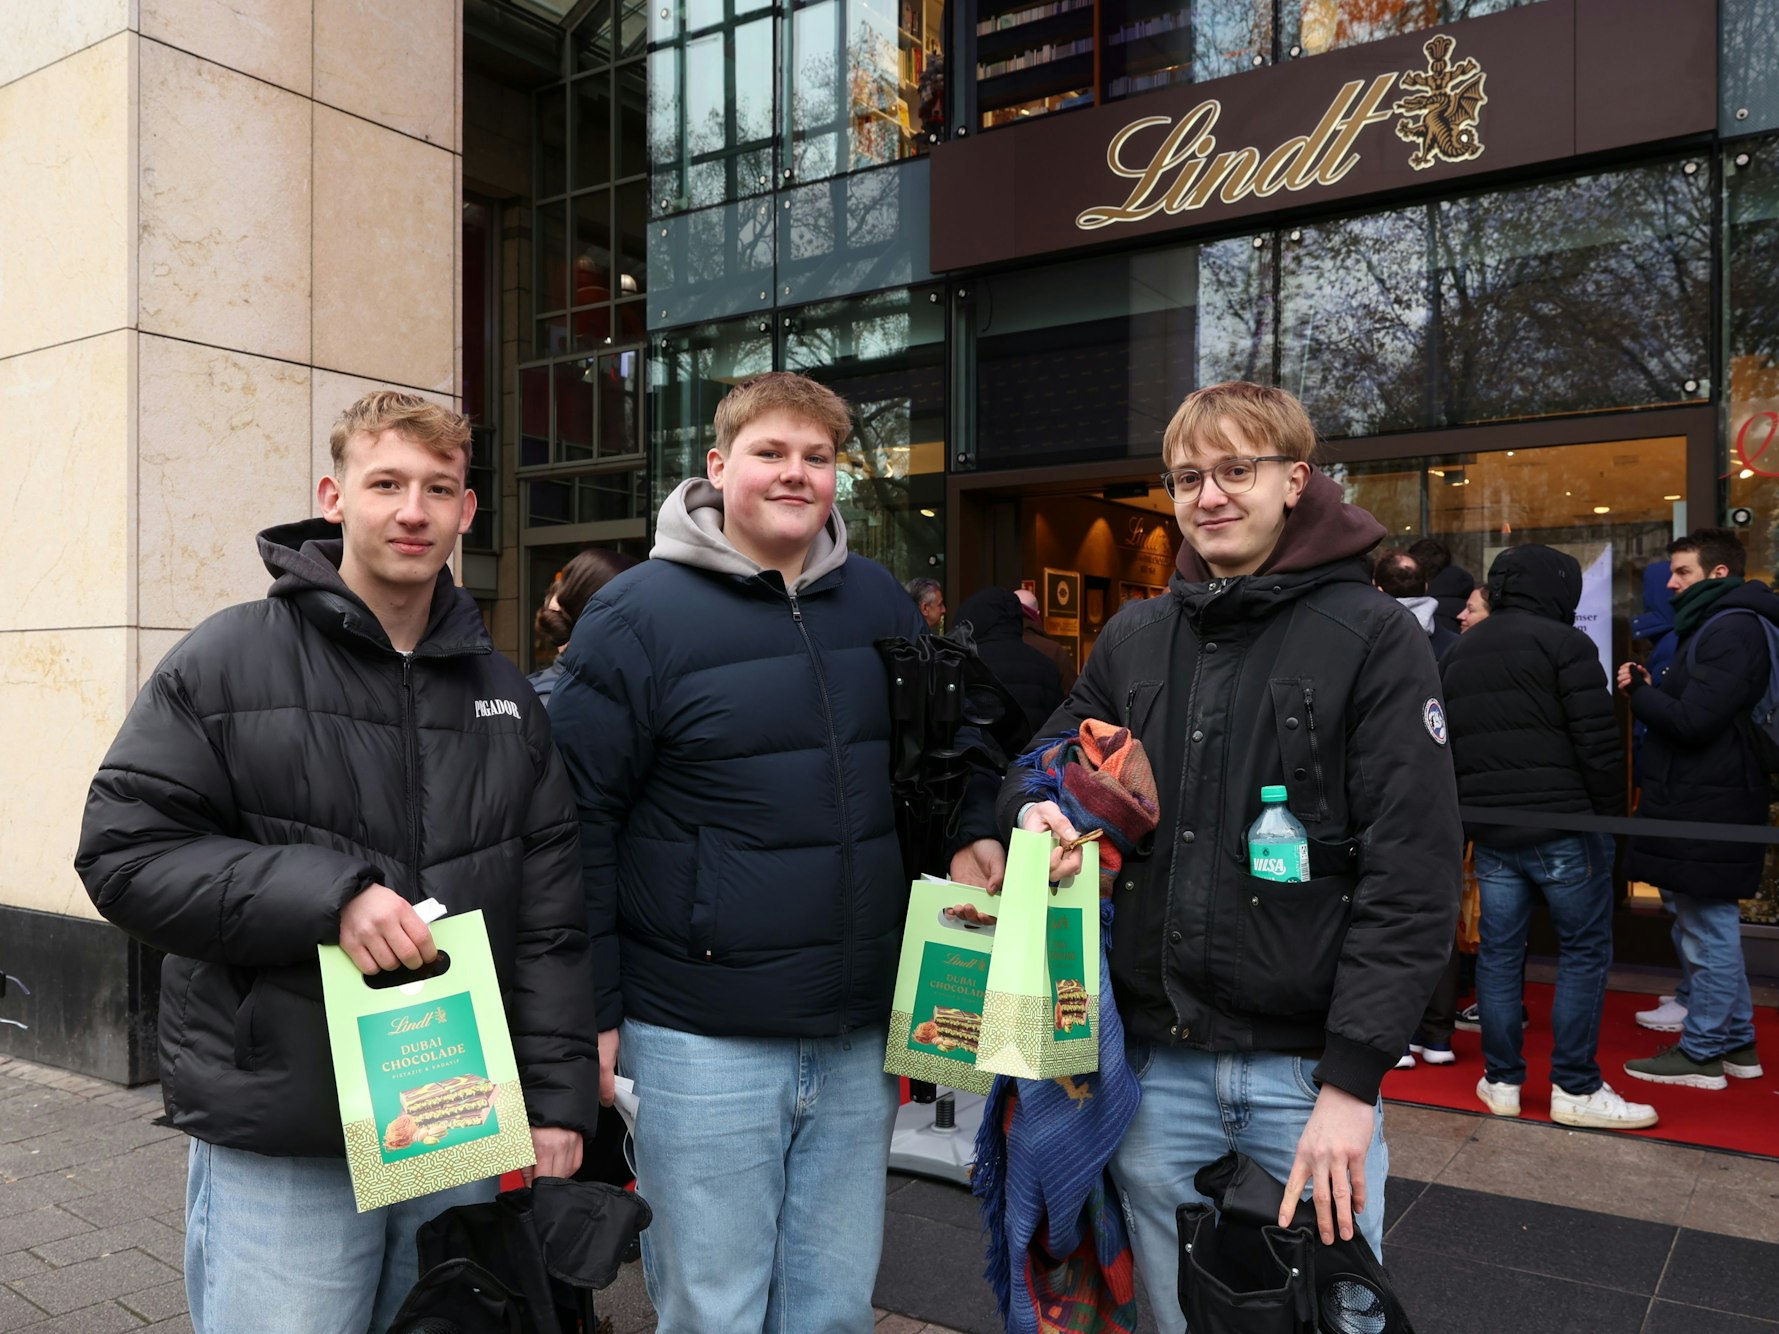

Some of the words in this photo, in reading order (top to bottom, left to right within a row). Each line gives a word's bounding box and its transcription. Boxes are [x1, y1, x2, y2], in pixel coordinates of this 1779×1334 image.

[1075, 71, 1399, 230] Lindt
[474, 699, 521, 719] PIGADOR
[1254, 858, 1287, 875] VILSA
[943, 952, 978, 968] Lindt
[947, 974, 976, 987] DUBAI
[387, 1011, 434, 1035] Lindt
[401, 1037, 442, 1055] DUBAI
[382, 1043, 465, 1072] CHOCOLADE
